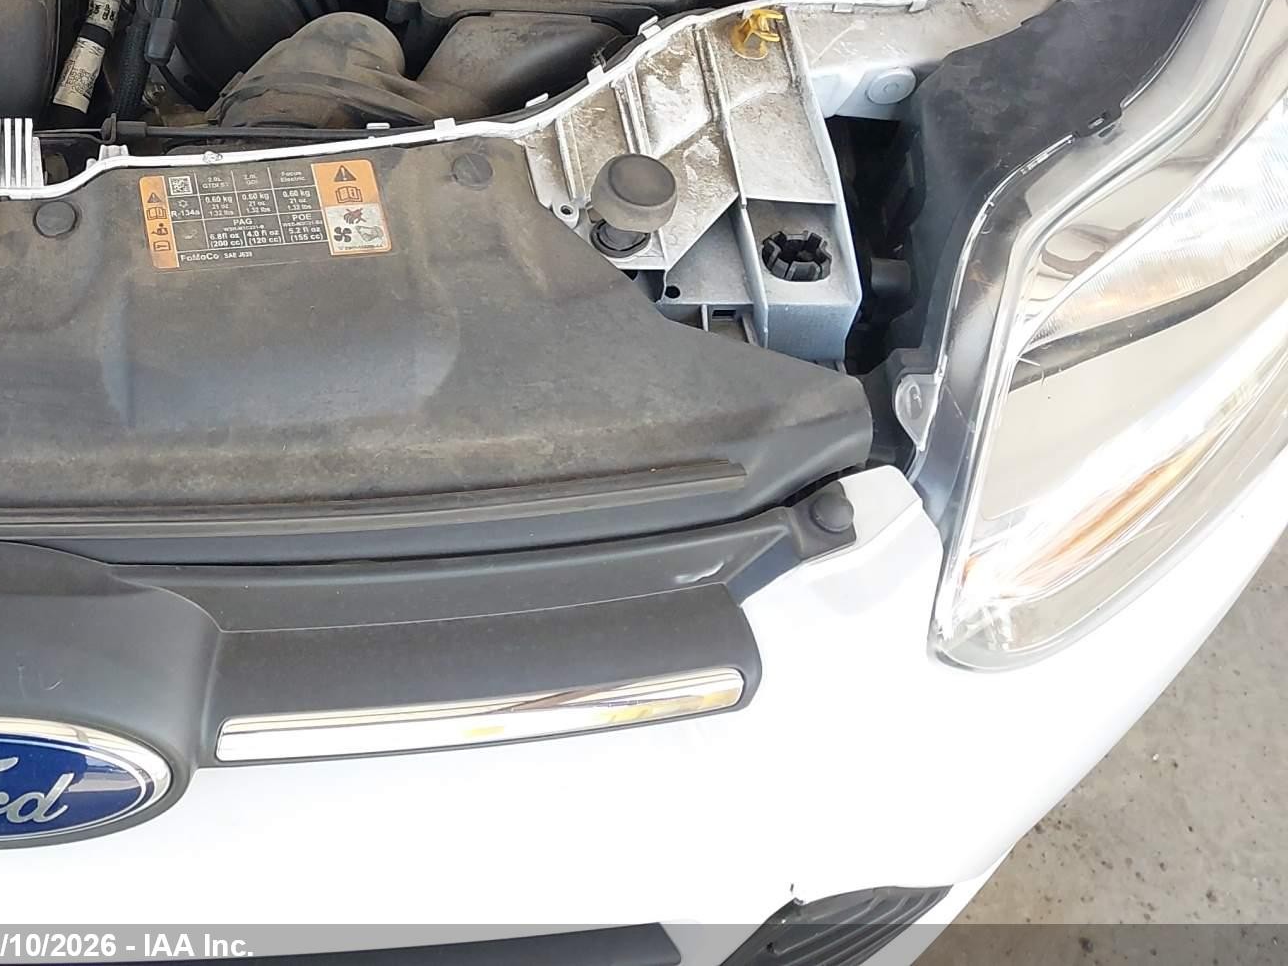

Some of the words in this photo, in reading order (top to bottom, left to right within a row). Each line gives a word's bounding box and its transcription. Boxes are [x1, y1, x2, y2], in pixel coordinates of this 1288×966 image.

[259, 192, 270, 200] kg
[300, 189, 310, 197] kg
[223, 195, 233, 203] kg
[171, 209, 200, 217] R-134a
[291, 213, 312, 221] POE
[248, 237, 267, 245] (120
[290, 234, 309, 242] (155
[309, 232, 323, 240] cc)
[210, 240, 229, 248] (200
[180, 252, 220, 262] FoMoCo
